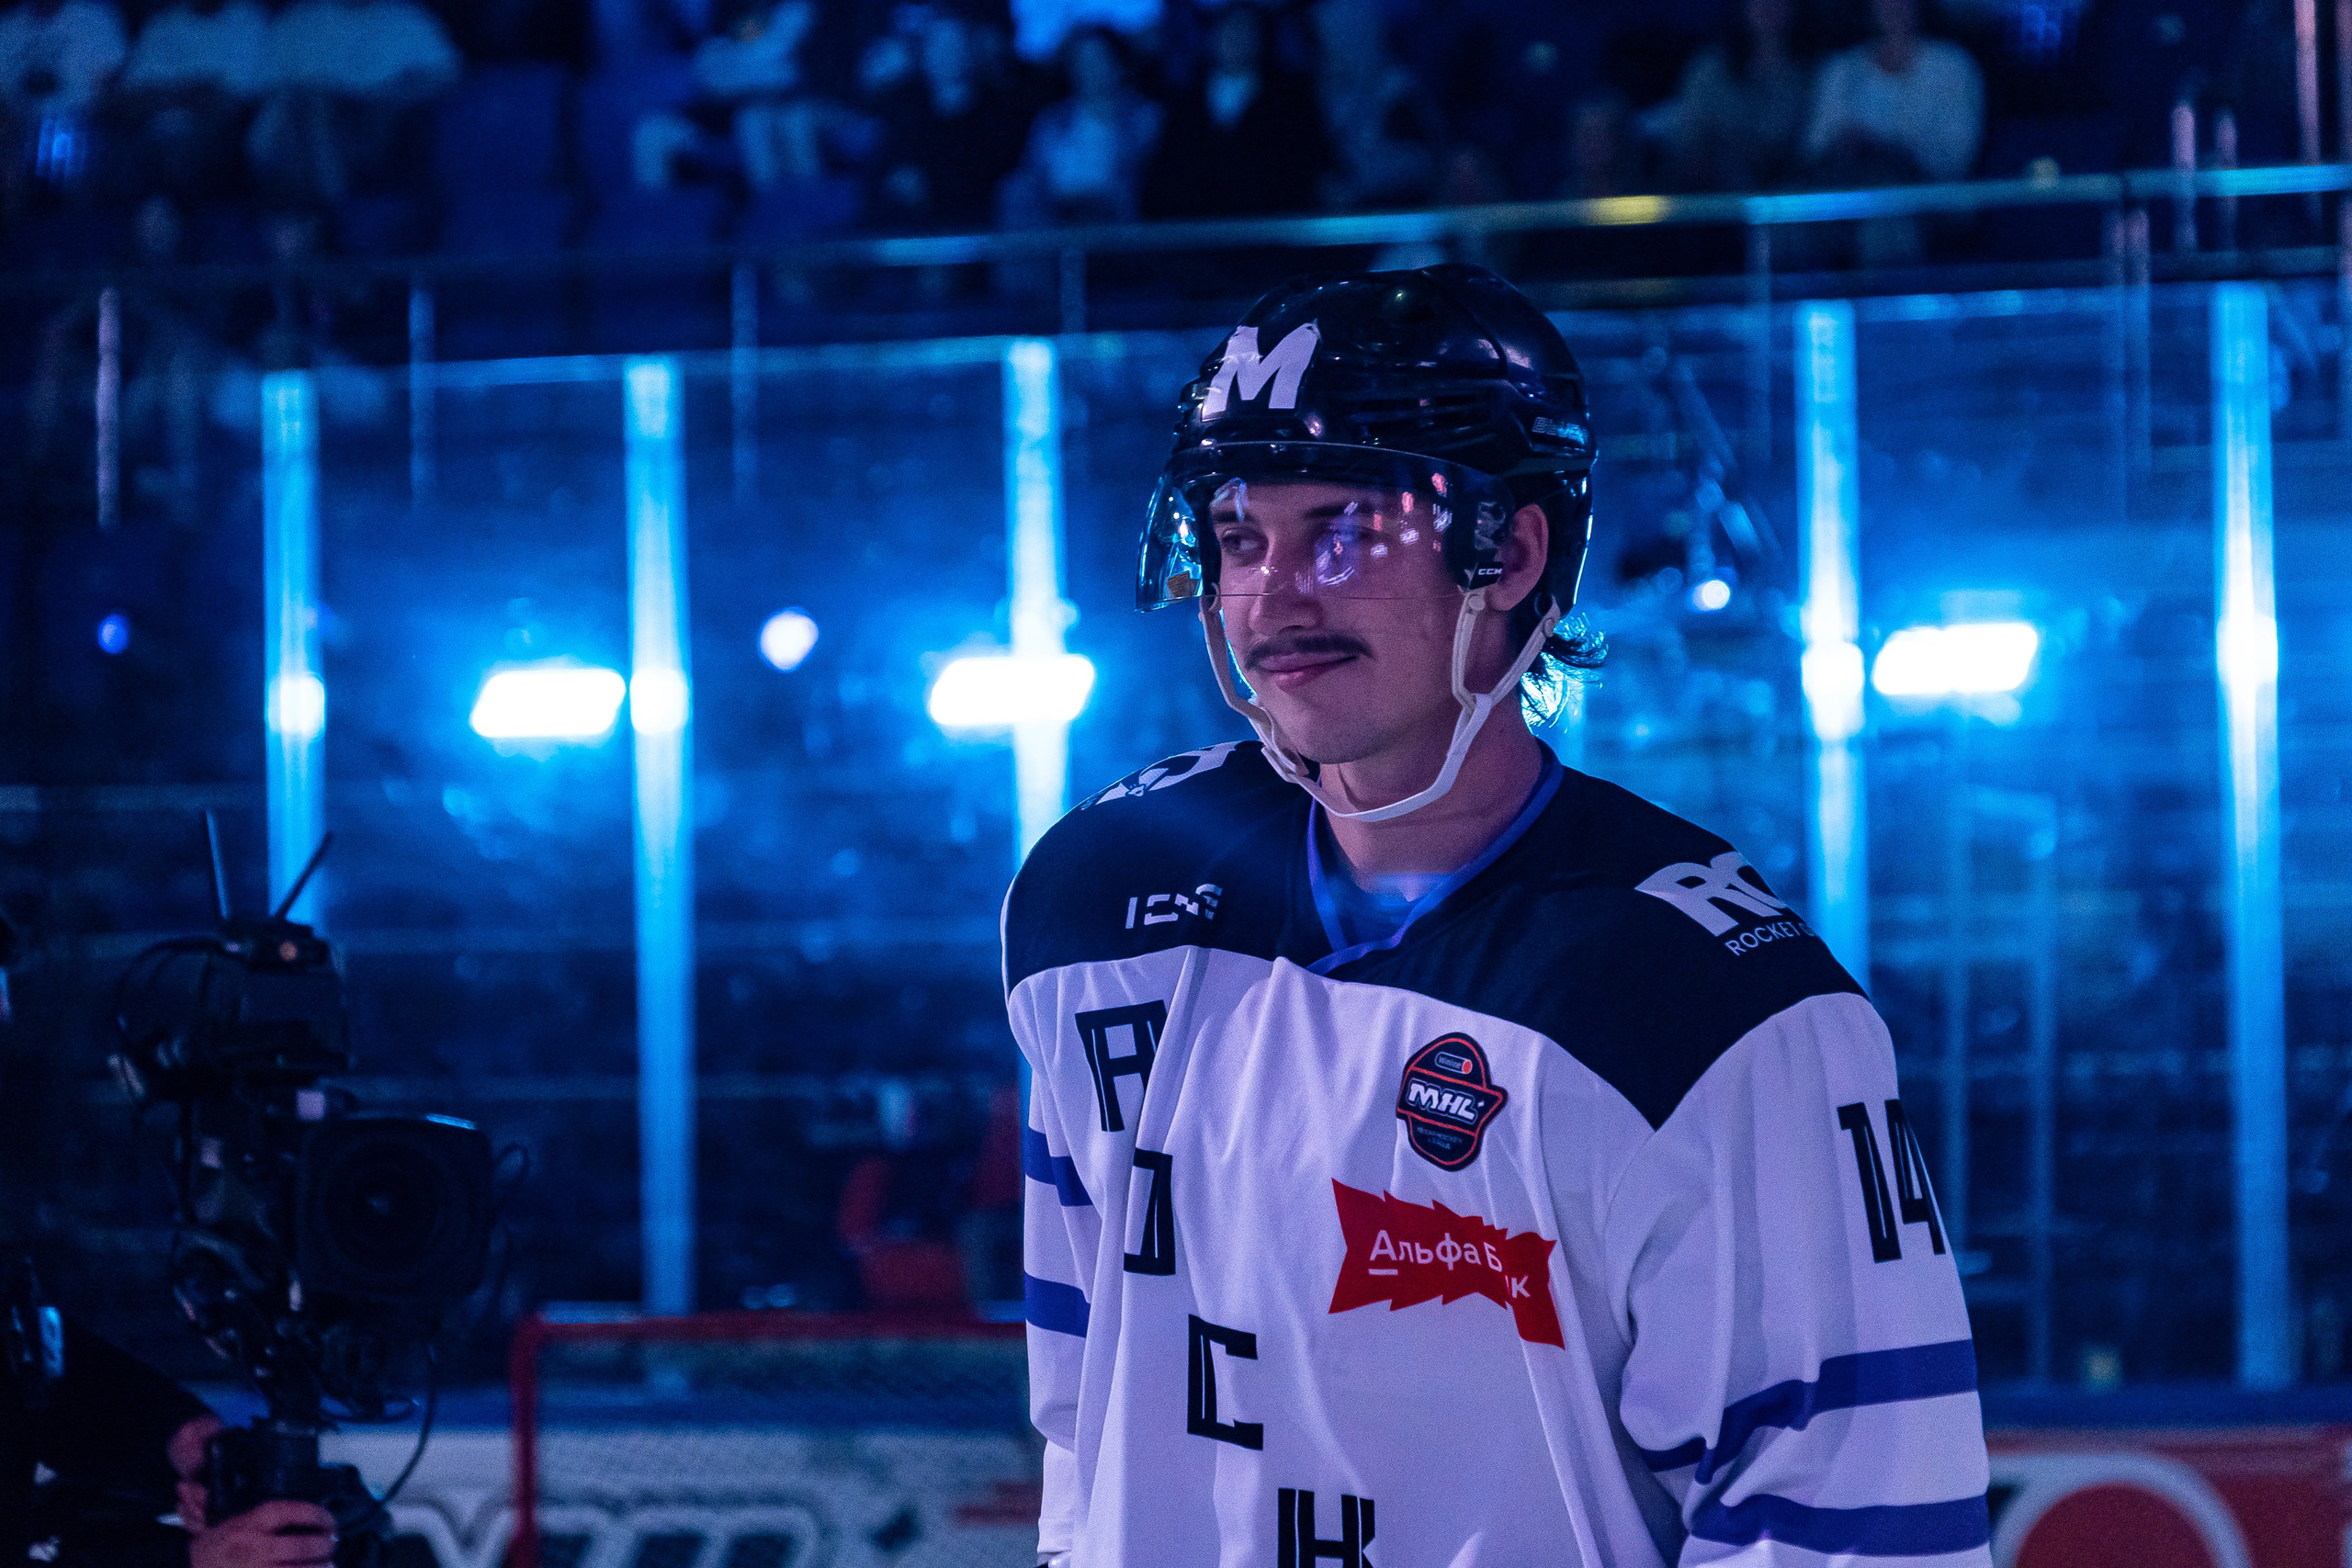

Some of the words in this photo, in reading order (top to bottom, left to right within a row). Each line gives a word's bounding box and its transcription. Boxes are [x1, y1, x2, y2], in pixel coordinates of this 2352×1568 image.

[1201, 321, 1321, 413] M
[1477, 568, 1503, 576] CCM
[1724, 921, 1801, 956] ROCKET
[1408, 1082, 1476, 1121] MHL
[1837, 1099, 1946, 1264] 14
[1368, 1228, 1482, 1272] Альфа
